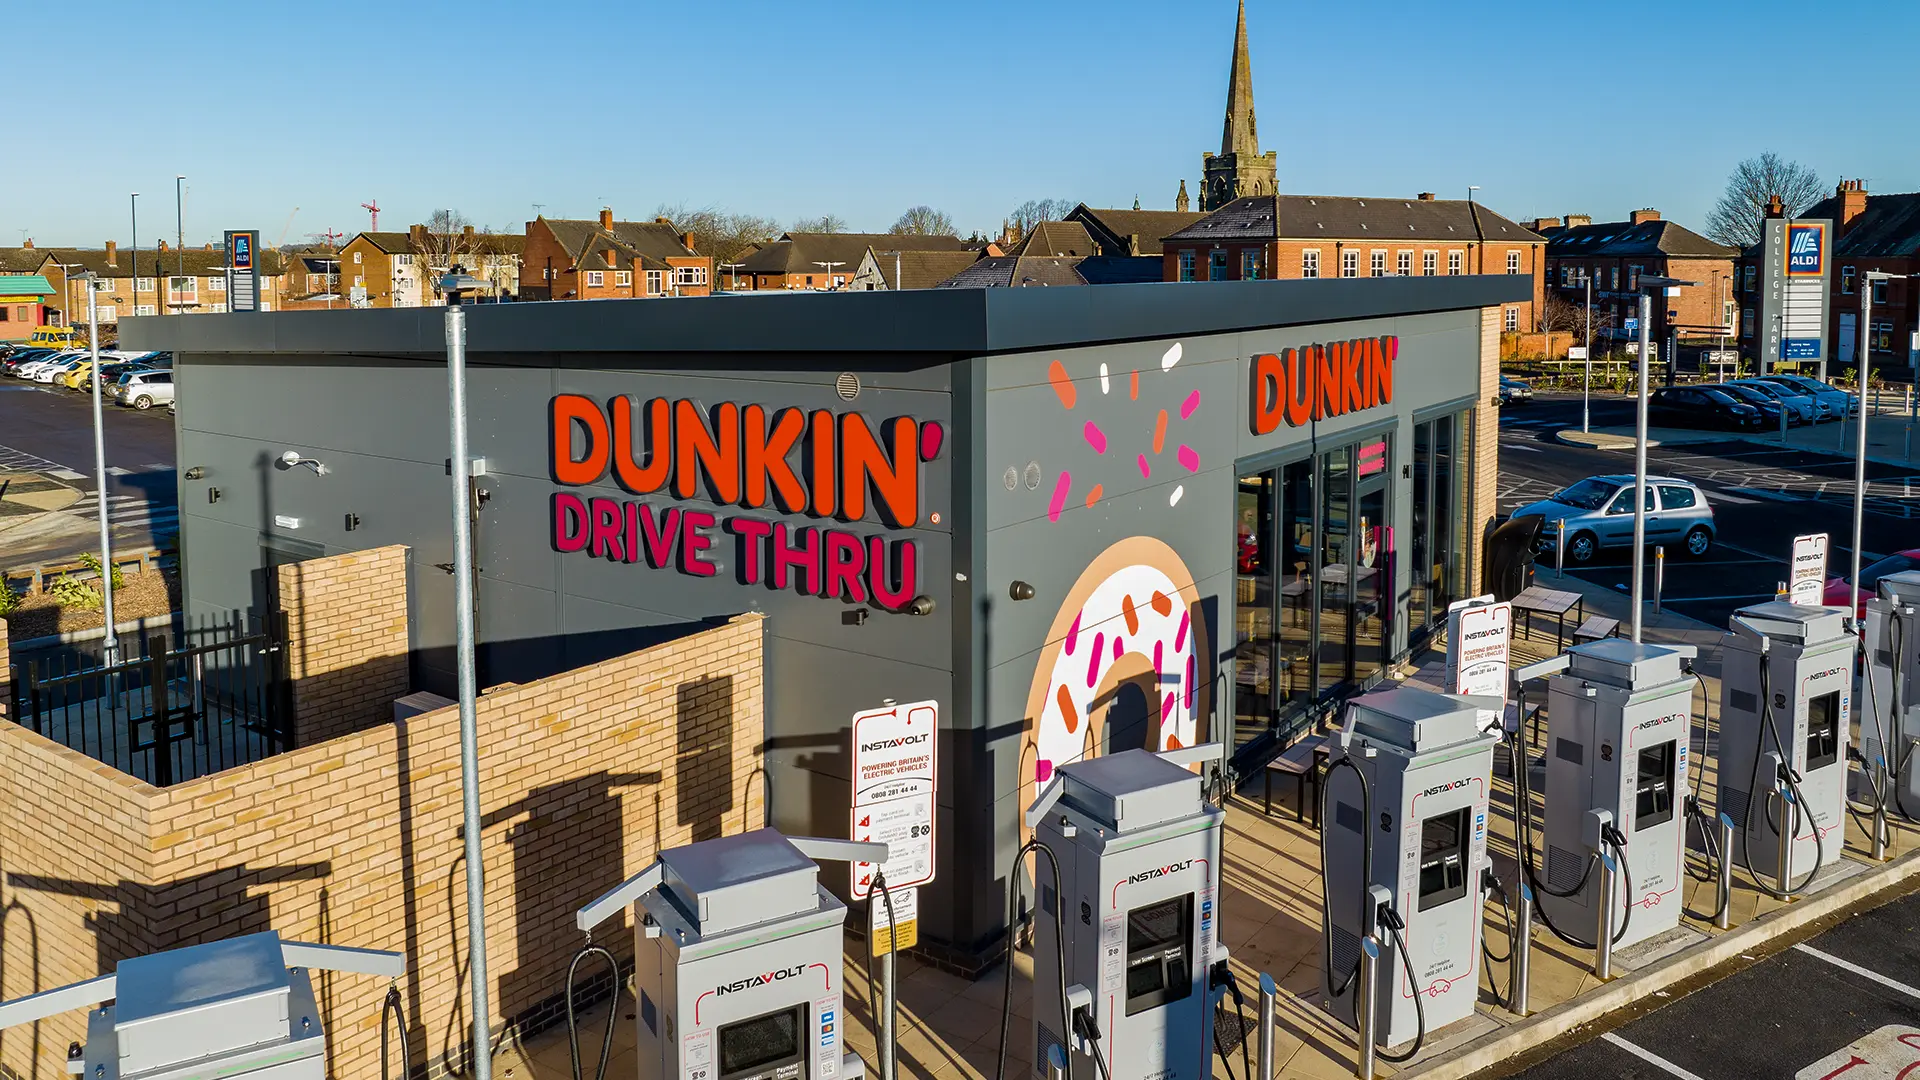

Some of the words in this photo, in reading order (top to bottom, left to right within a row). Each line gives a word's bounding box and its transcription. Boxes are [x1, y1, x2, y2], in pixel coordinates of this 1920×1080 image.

[1773, 225, 1781, 300] COLLEGE
[1790, 256, 1818, 266] ALDI
[1770, 314, 1778, 354] PARK
[1252, 335, 1399, 436] DUNKIN'
[551, 393, 944, 529] DUNKIN'
[554, 493, 717, 577] DRIVE
[731, 516, 917, 610] THRU
[1796, 553, 1823, 562] INSTAVOLT
[1464, 627, 1505, 641] INSTAVOLT
[1809, 667, 1840, 681] INSTAVOLT
[1639, 713, 1676, 730] INSTAVOLT
[861, 733, 929, 753] INSTAVOLT
[861, 760, 897, 773] POWERING
[898, 754, 930, 766] BRITAIN'S
[863, 768, 895, 780] ELECTRIC
[896, 762, 928, 774] VEHICLES
[871, 790, 886, 799] 0808
[888, 788, 899, 796] 281
[1423, 777, 1472, 797] INSTAVOLT
[1128, 859, 1194, 885] INSTAVOLT
[1141, 955, 1155, 963] Screen
[716, 963, 806, 996] INSTAVOLT
[776, 1063, 798, 1073] Payment
[777, 1069, 799, 1079] Terminal
